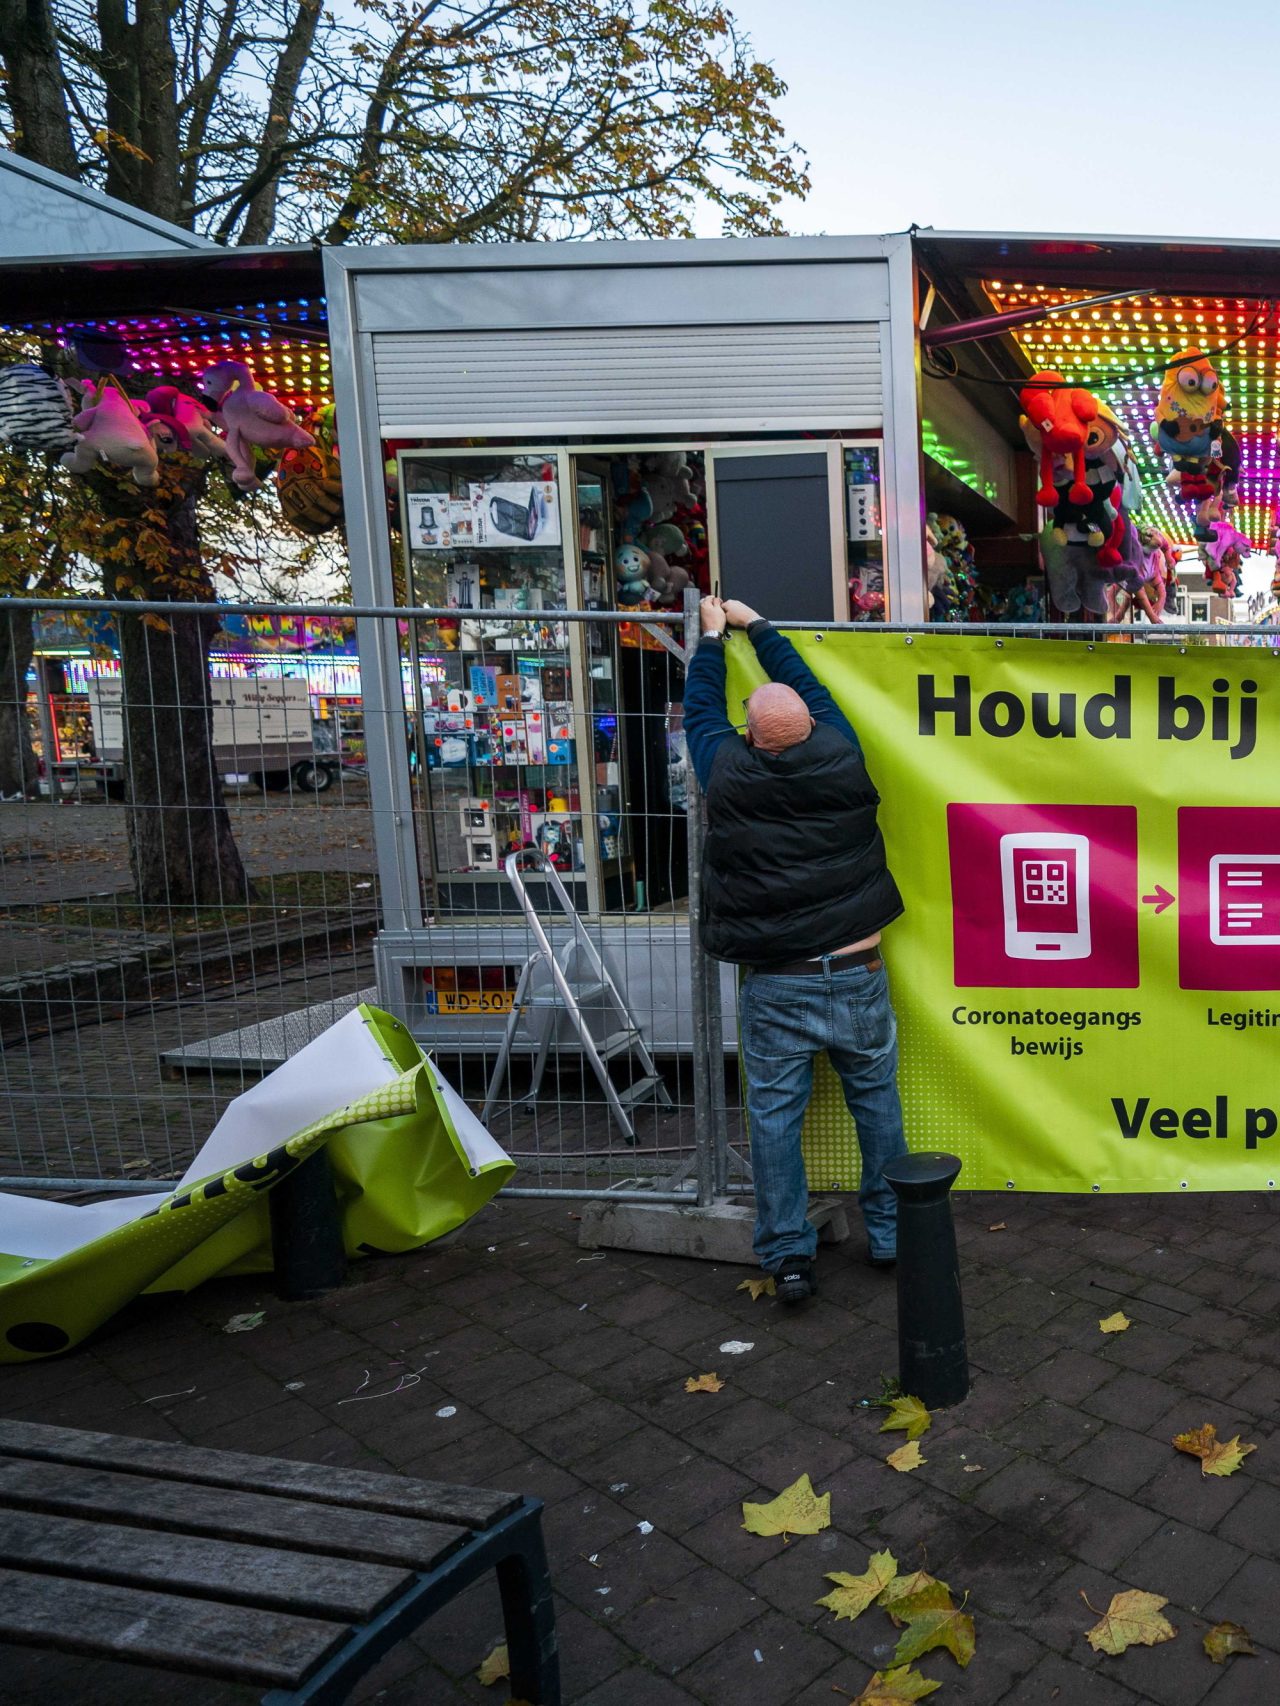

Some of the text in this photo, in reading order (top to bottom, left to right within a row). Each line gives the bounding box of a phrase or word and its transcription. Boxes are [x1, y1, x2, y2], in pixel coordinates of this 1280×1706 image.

[917, 674, 1132, 740] Houd
[1157, 675, 1258, 760] bij
[445, 992, 516, 1011] WD-60-
[1011, 1036, 1084, 1061] bewijs
[1111, 1095, 1228, 1139] Veel
